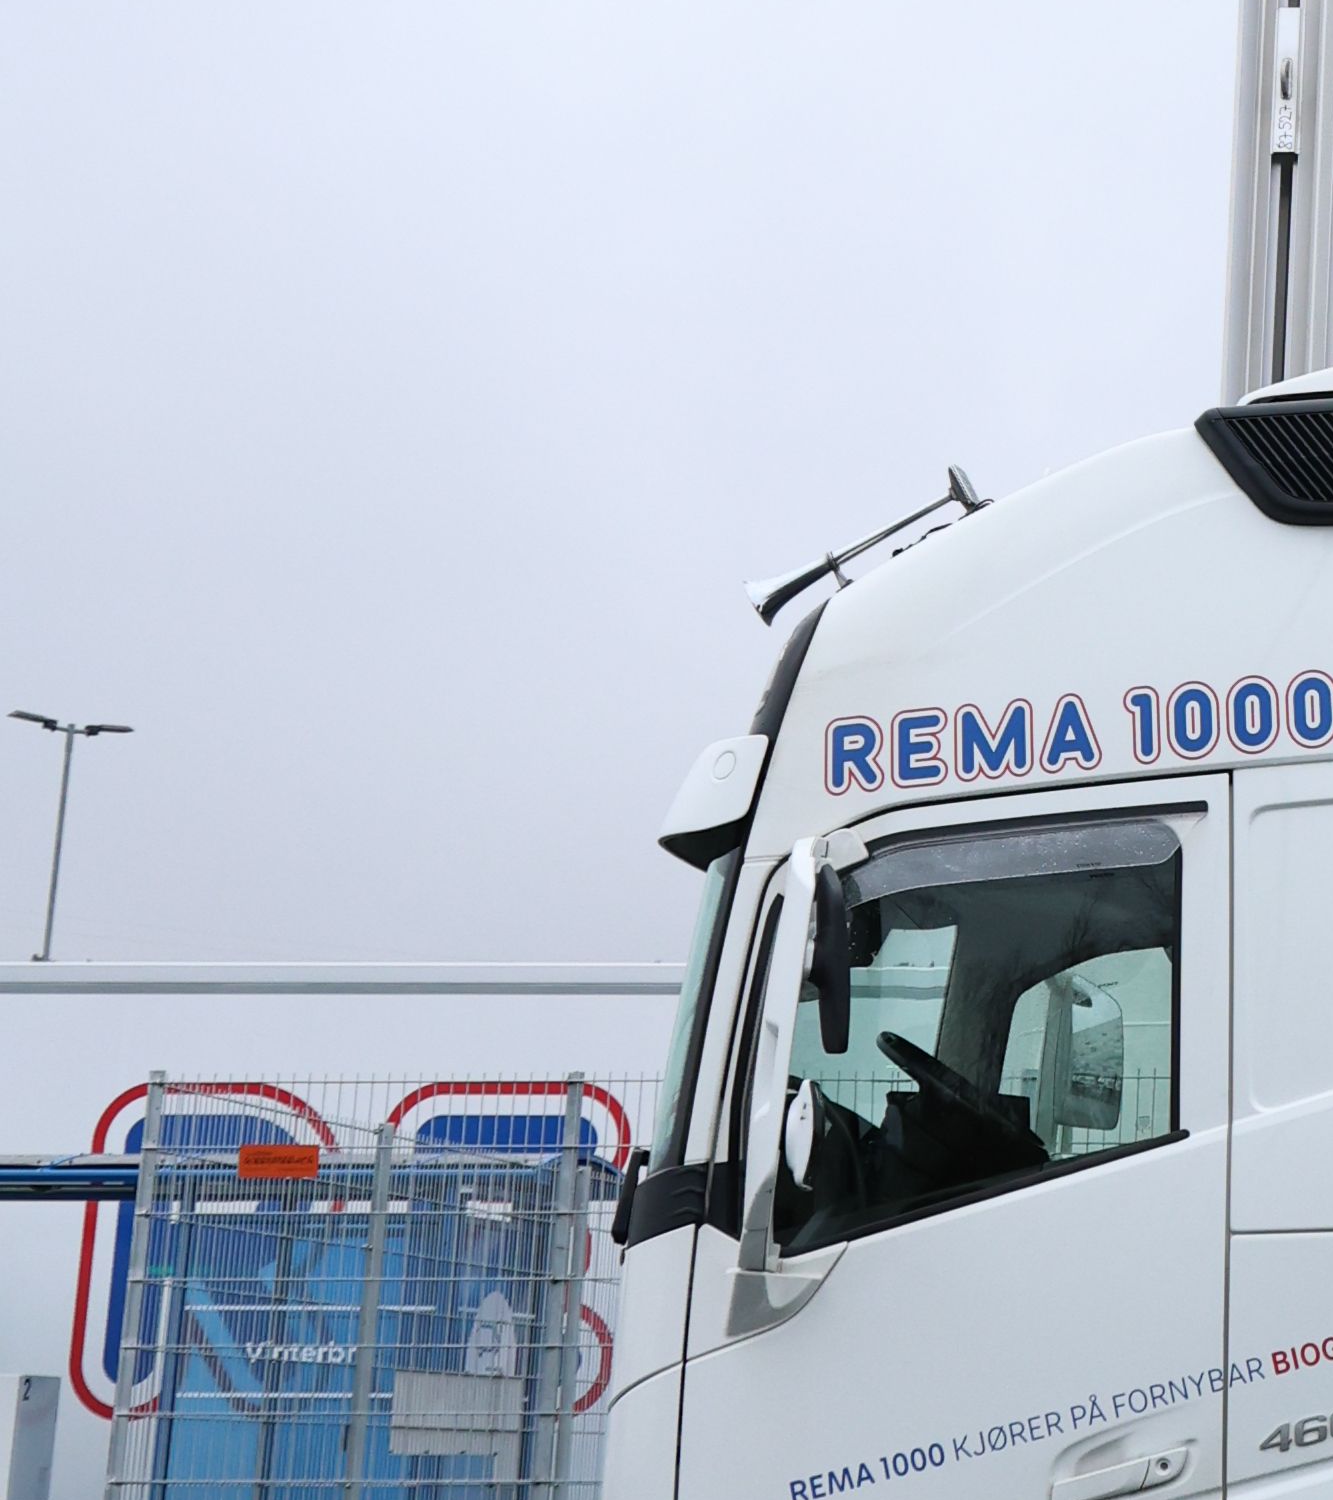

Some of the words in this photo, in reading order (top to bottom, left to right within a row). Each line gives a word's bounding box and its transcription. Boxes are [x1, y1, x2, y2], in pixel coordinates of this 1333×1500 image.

[825, 694, 1102, 795] REMA
[22, 1378, 32, 1401] 2
[880, 1442, 946, 1479] 1000
[952, 1412, 1065, 1462] KJØRER
[1071, 1393, 1109, 1430] PÅ
[1113, 1357, 1265, 1415] FORNYBAR
